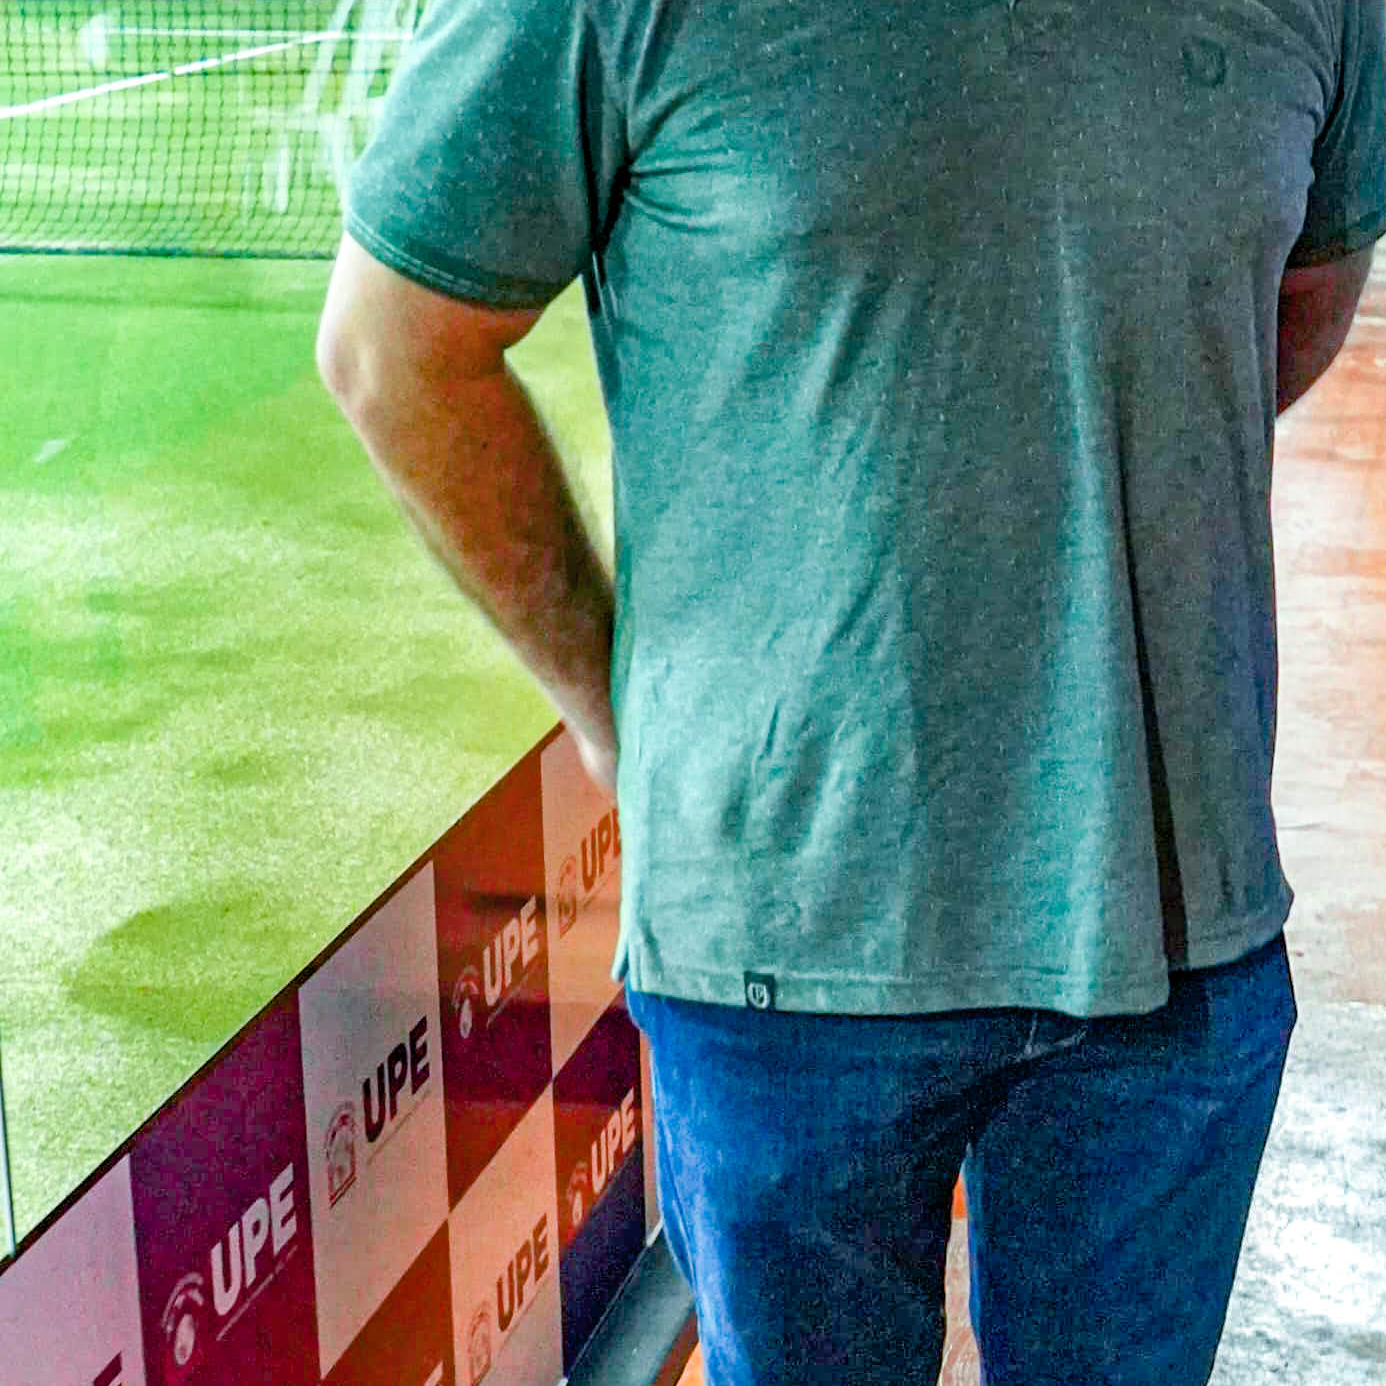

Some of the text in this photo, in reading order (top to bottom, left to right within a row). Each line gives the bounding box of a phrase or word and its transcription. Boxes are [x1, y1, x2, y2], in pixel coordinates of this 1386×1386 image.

[483, 894, 538, 1006] UPE
[362, 1016, 429, 1143] UPE
[592, 1086, 635, 1195] UPE
[210, 1163, 296, 1315] UPE
[497, 1214, 549, 1332] UPE
